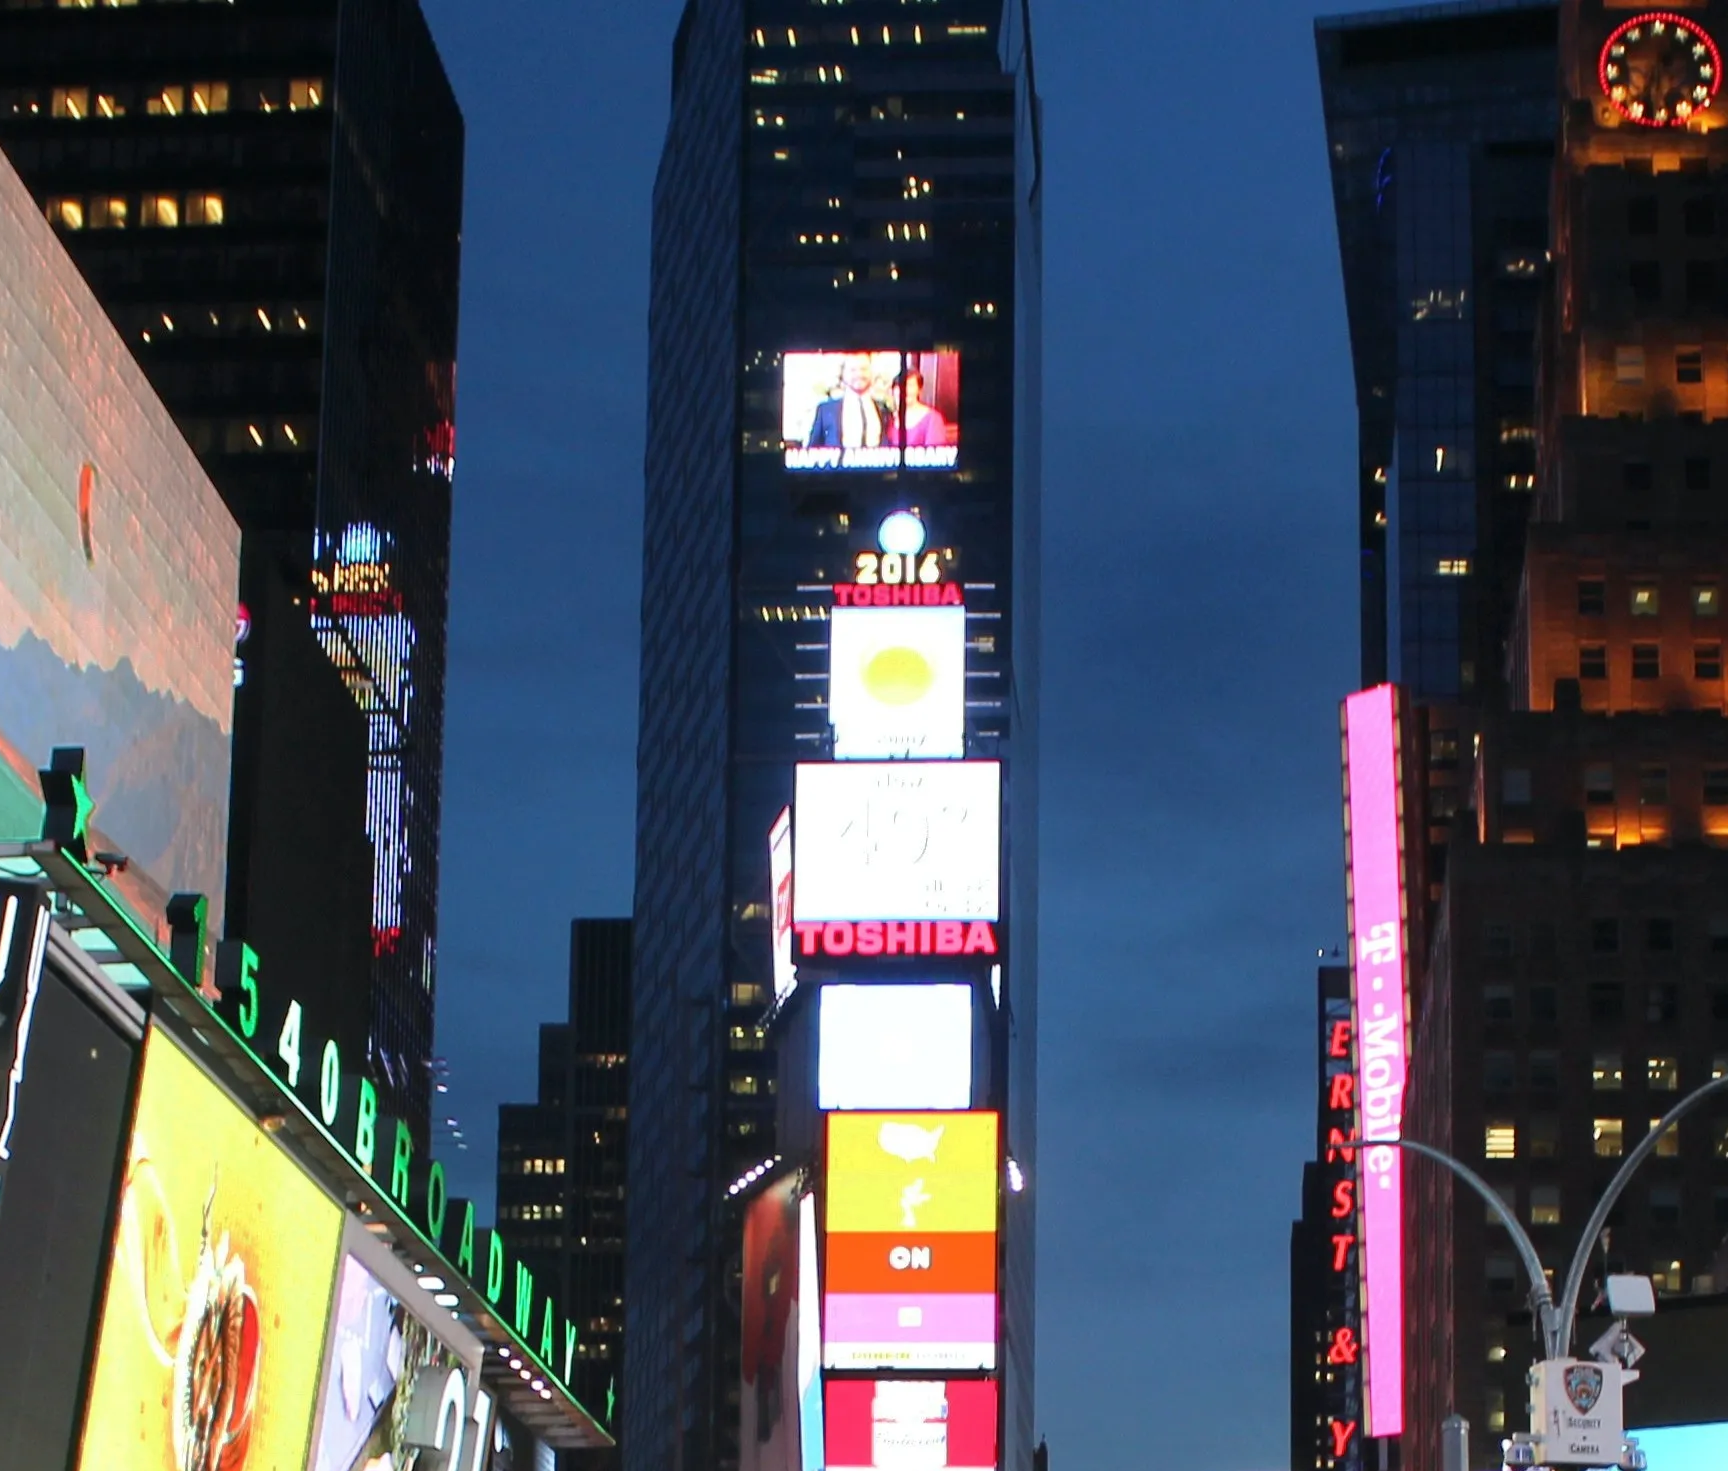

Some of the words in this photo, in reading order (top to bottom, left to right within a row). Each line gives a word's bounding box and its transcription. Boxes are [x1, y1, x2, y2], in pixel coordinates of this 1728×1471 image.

[855, 551, 941, 584] 2016
[833, 583, 964, 606] TOSHIBA
[793, 920, 997, 955] TOSHIBA
[192, 894, 340, 1127] 1540
[354, 1074, 580, 1385] BROADWAY
[1328, 1018, 1359, 1274] ERNST
[888, 1245, 930, 1271] ON
[1328, 1335, 1359, 1365] &
